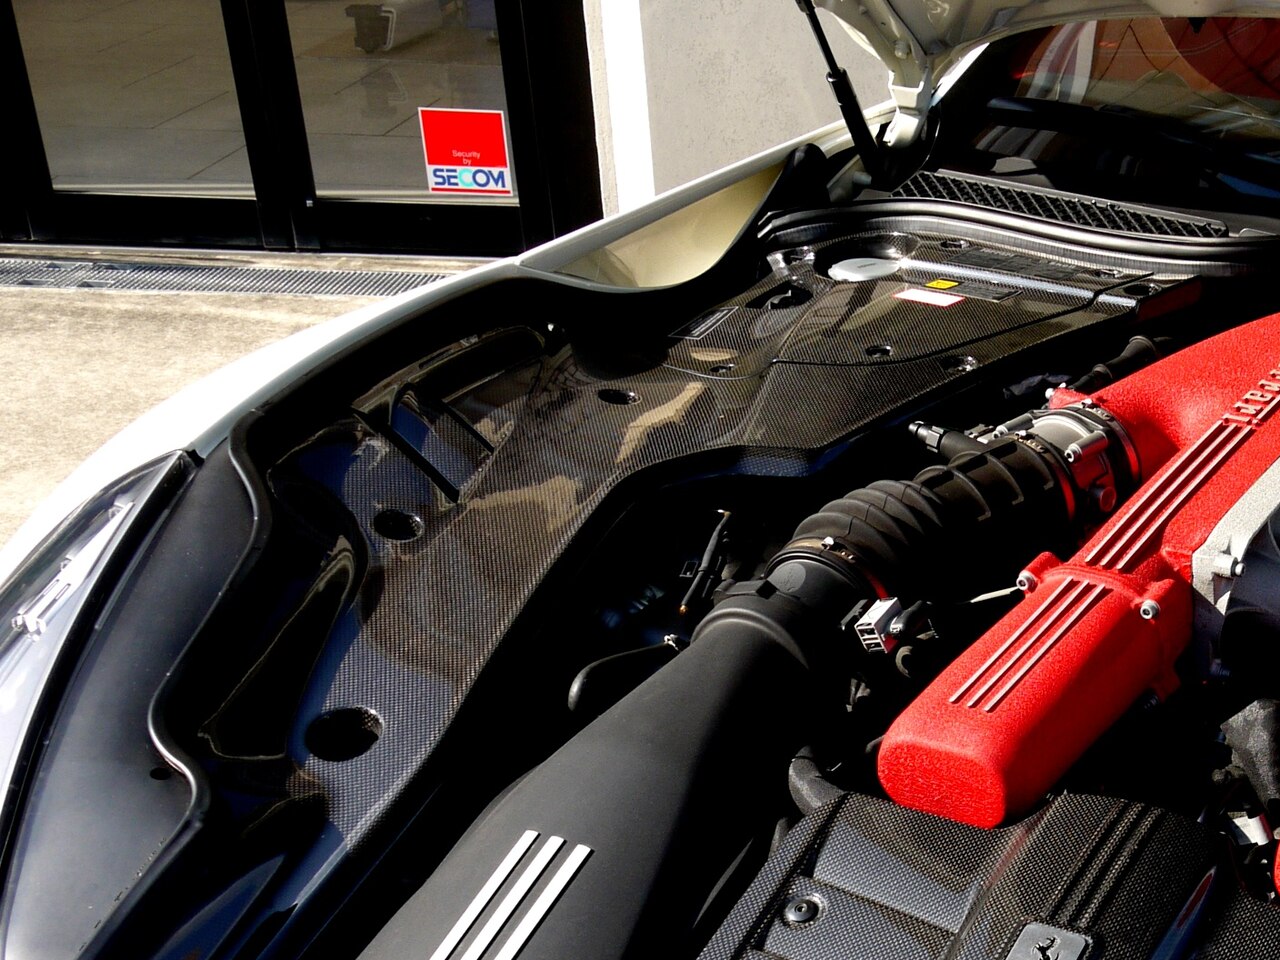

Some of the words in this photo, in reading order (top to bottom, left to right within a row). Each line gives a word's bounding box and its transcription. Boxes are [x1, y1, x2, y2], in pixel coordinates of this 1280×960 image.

[452, 149, 481, 160] Security
[462, 157, 472, 167] by
[433, 168, 506, 188] SECOM
